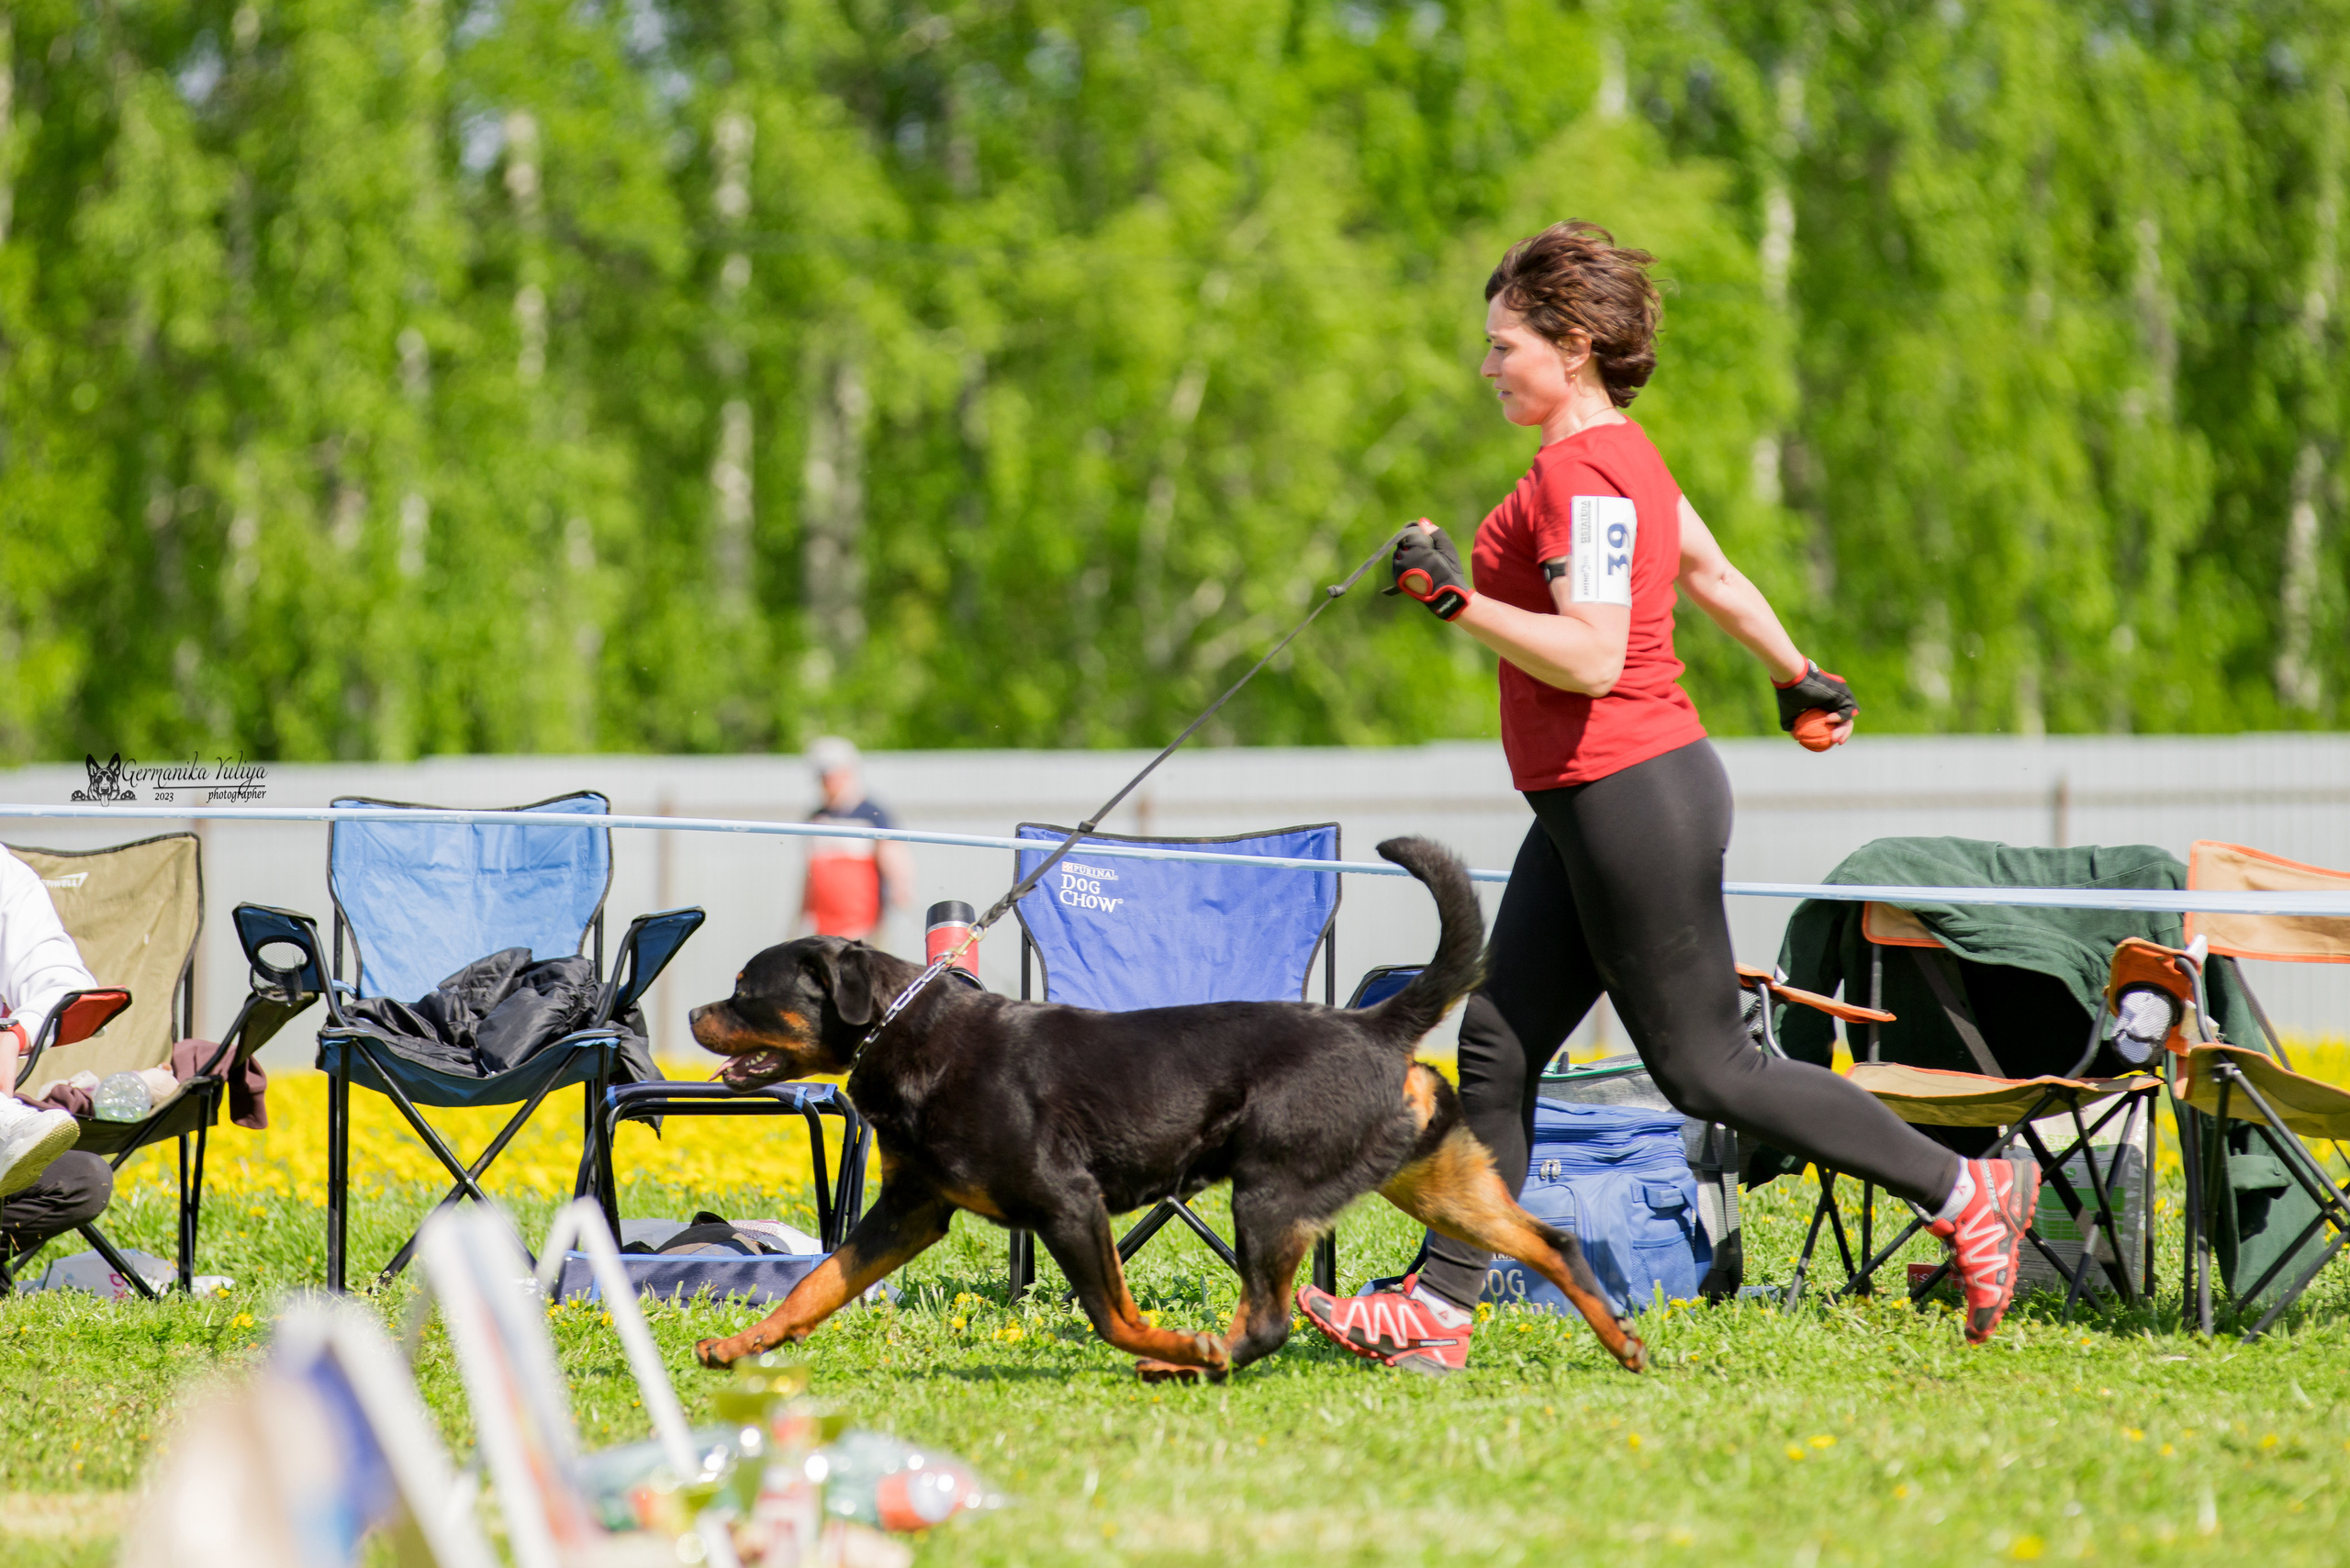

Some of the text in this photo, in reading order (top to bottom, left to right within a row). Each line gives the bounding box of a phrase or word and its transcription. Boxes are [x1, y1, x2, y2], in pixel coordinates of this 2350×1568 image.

[1607, 522, 1630, 577] 39
[1073, 865, 1112, 879] PURINA
[1060, 874, 1101, 894] DOG
[1059, 890, 1118, 913] CHOW
[1479, 1269, 1526, 1297] OG
